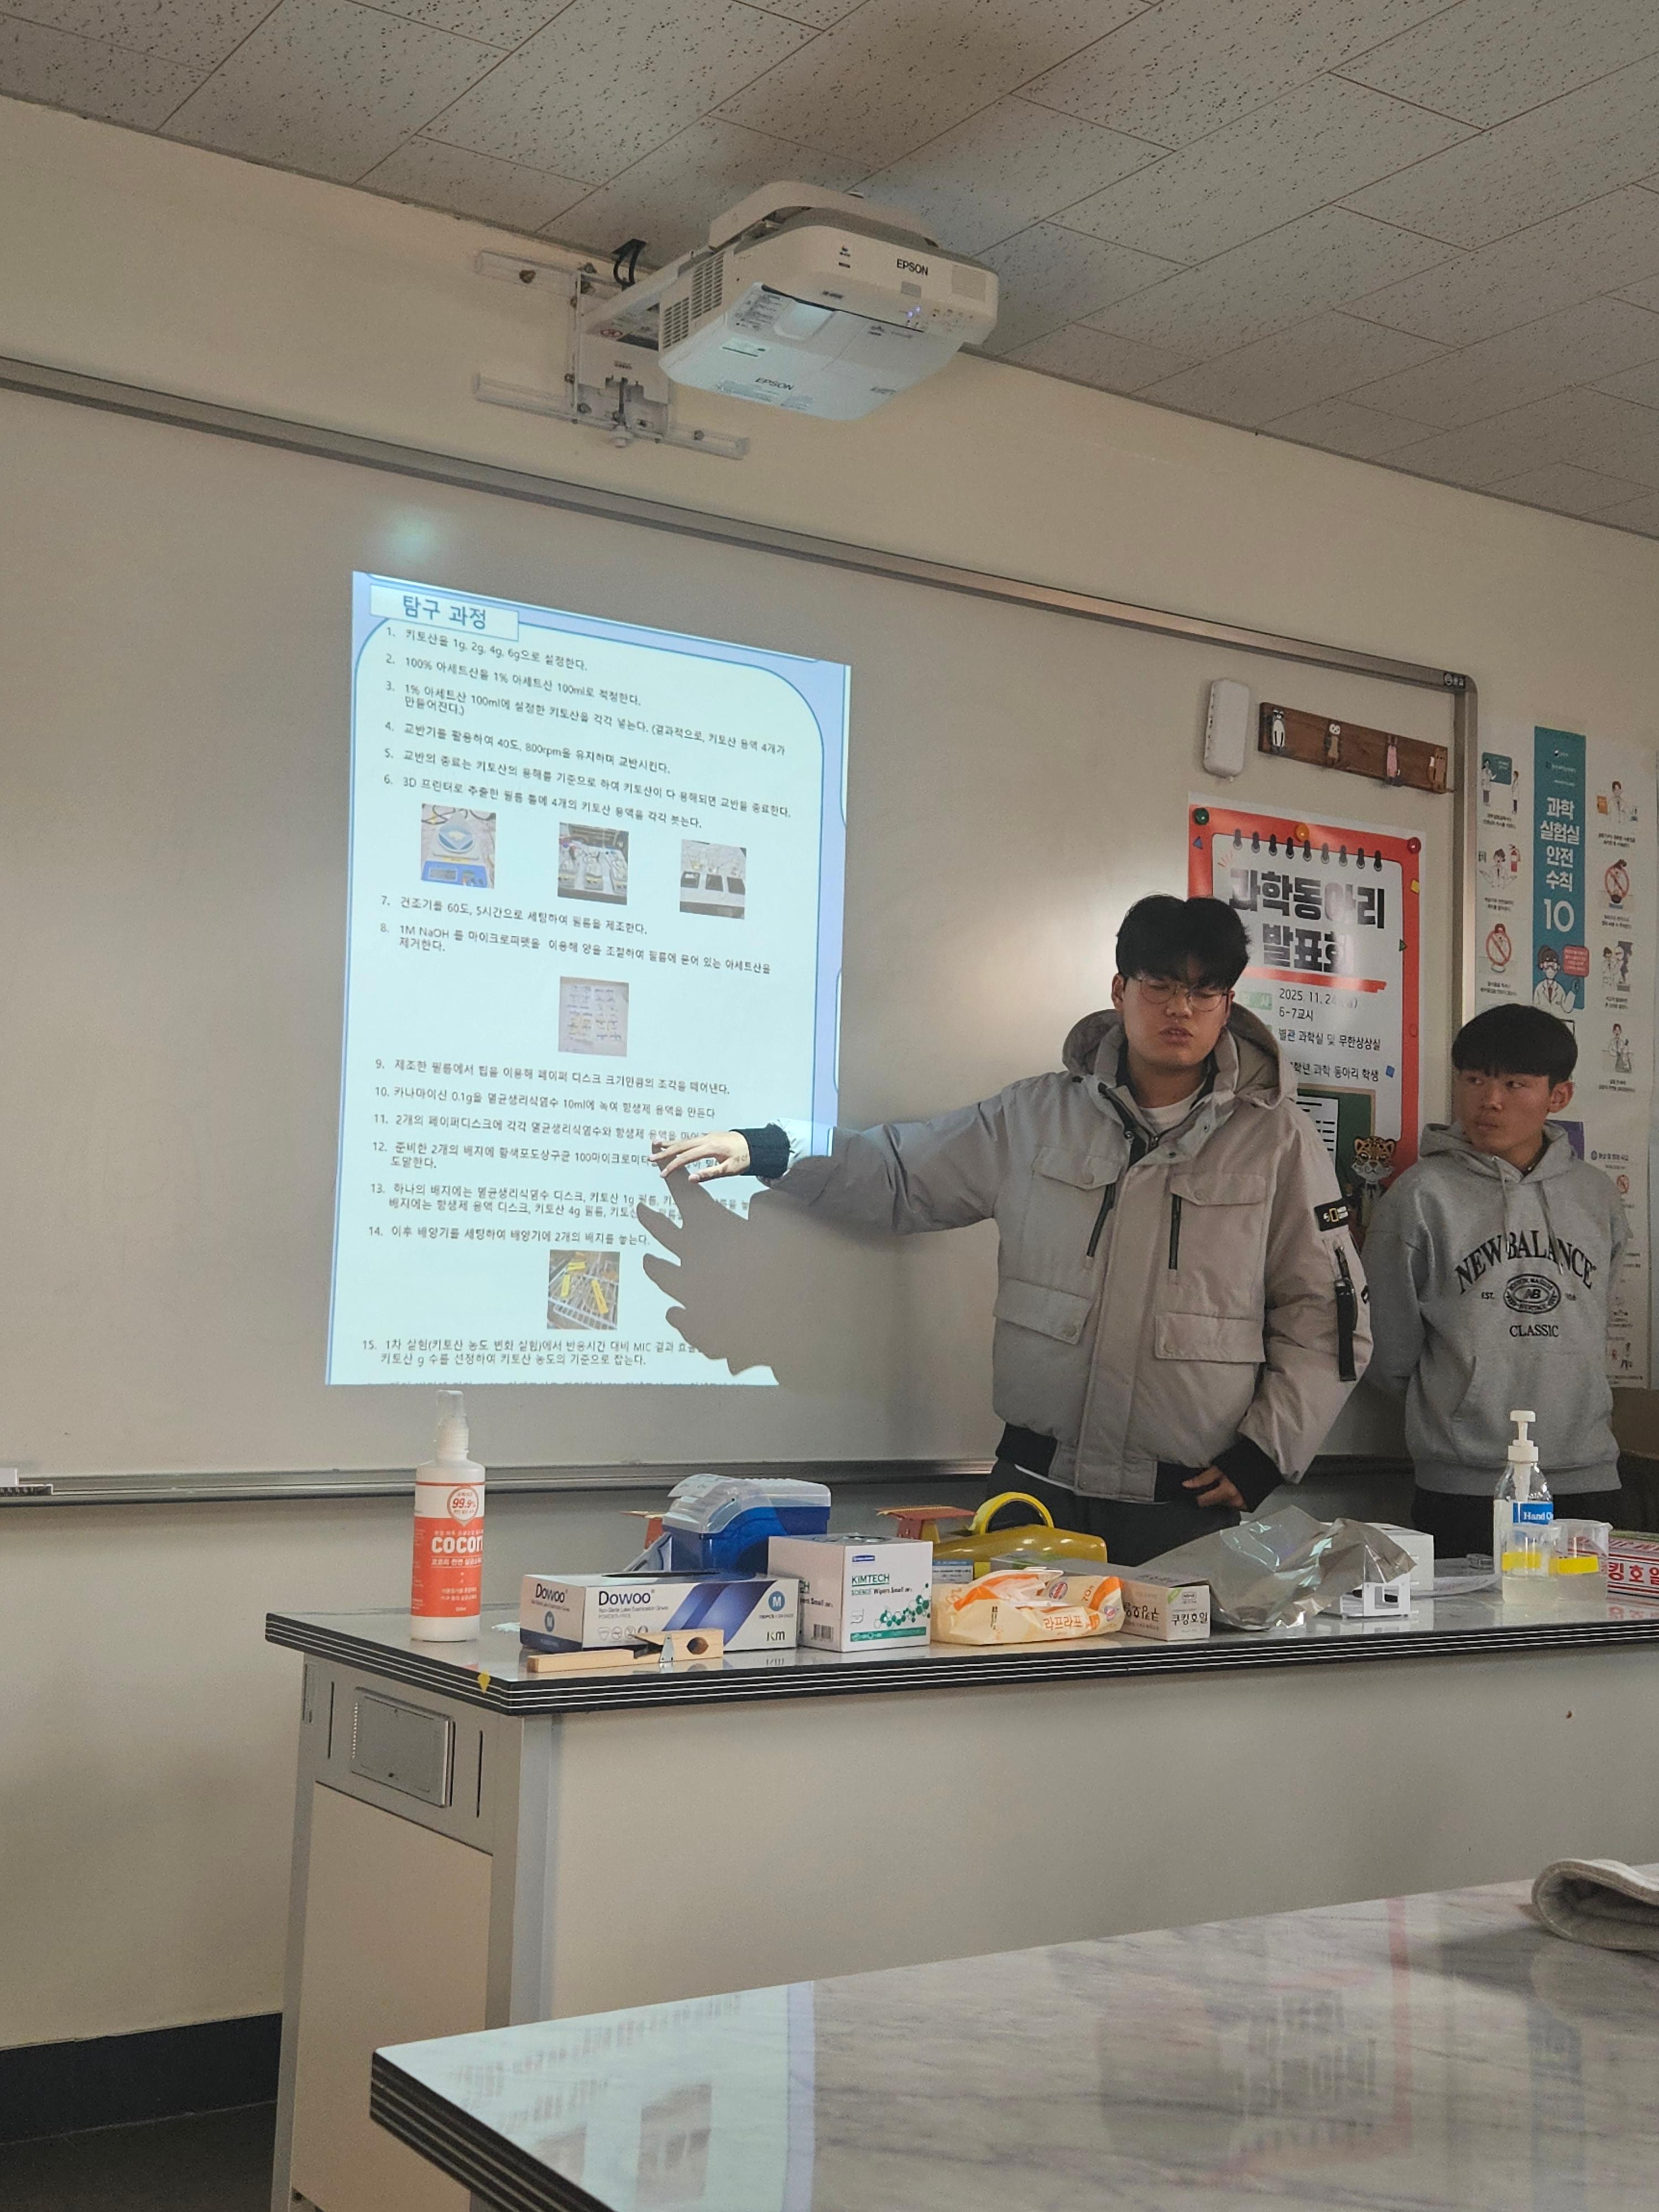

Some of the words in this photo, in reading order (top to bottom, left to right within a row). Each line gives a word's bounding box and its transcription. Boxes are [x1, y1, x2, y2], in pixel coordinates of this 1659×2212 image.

[896, 258, 928, 276] EPSON
[755, 377, 795, 390] EPSON
[403, 595, 441, 620] 탐구
[448, 606, 486, 630] 과정
[406, 629, 448, 648] 키토산을
[508, 648, 540, 662] 6g으로
[545, 654, 587, 671] 설정한다.
[405, 657, 432, 670] 100%
[436, 661, 488, 681] 아세트산을
[494, 672, 508, 684] 1%
[512, 674, 552, 692] 아세트산
[557, 682, 594, 697] 100ml로
[405, 684, 420, 695] 1%
[424, 686, 467, 703] 아세트산
[471, 695, 510, 711] 100ml에
[514, 701, 545, 716] 설정한
[549, 706, 588, 723] 키토산을
[593, 713, 612, 727] 각각
[708, 733, 736, 748] 키토산
[761, 743, 785, 756] 4개가
[404, 723, 447, 740] 교반기를
[497, 738, 521, 752] 40도,
[525, 742, 571, 759] 800rpm을
[575, 750, 614, 765] 유지하며
[619, 756, 670, 774] 교반시킨다.
[403, 750, 436, 765] 교반의
[476, 760, 517, 776] 키토산의
[556, 772, 596, 787] 기준으로
[600, 779, 619, 792] 하여
[623, 782, 662, 799] 키토산이
[666, 789, 676, 800] 다
[403, 776, 416, 787] 3D
[420, 778, 463, 794] 프린터로
[551, 797, 577, 810] 4개의
[582, 801, 611, 816] 키토산
[648, 811, 666, 823] 각각
[1546, 796, 1575, 820] 과학
[1540, 820, 1580, 845] 실험실
[1546, 845, 1574, 868] 안전
[1546, 870, 1573, 893] 수칙
[1229, 868, 1385, 929] 과학동아리
[400, 896, 442, 912] 건조기를
[447, 902, 472, 916] 60도,
[476, 906, 523, 920] 5시간으로
[527, 911, 567, 926] 세팅하여
[606, 920, 647, 935] 제조한다.
[1543, 898, 1575, 932] 10
[399, 936, 445, 952] 제거한다.
[400, 925, 415, 935] 1M
[419, 926, 449, 938] NaOH
[549, 940, 578, 953] 이용해
[725, 959, 770, 974] 아세트산을
[1310, 991, 1322, 1004] 11.
[1279, 1006, 1313, 1022] 6-7교시
[1299, 1030, 1324, 1045] 과학실
[1339, 1035, 1381, 1051] 무한상상실
[394, 1059, 426, 1073] 제조한
[503, 1067, 533, 1079] 이용해
[538, 1069, 567, 1082] 페이퍼
[572, 1072, 601, 1084] 디스크
[658, 1079, 686, 1092] 조각을
[1290, 1061, 1311, 1076] 학년
[1313, 1063, 1331, 1077] 과학
[1333, 1065, 1359, 1079] 동아리
[1361, 1068, 1379, 1082] 학생
[394, 1086, 447, 1101] 카나마이신
[451, 1091, 482, 1105] 0.1g을
[488, 1092, 559, 1108] 멸균생리식염수
[564, 1099, 594, 1110] 10ml에
[622, 1102, 650, 1115] 항생제
[687, 1107, 715, 1119] 만든다
[395, 1114, 423, 1126] 2개의
[428, 1115, 502, 1131] 페이퍼디스크에
[507, 1120, 526, 1133] 각각
[531, 1121, 612, 1137] 멸균생리식염수와
[615, 1127, 644, 1139] 항생제
[395, 1141, 427, 1155] 준비한
[431, 1144, 458, 1156] 2개의
[463, 1145, 494, 1158] 배지에
[390, 1156, 436, 1169] 도말한다.
[394, 1183, 425, 1196] 하나의
[430, 1185, 472, 1198] 배지에는
[477, 1186, 549, 1201] 멸균생리식염수
[554, 1190, 586, 1203] 디스크,
[589, 1191, 618, 1204] 키토산
[623, 1194, 634, 1207] 1g
[389, 1197, 432, 1211] 배지에는
[436, 1199, 468, 1211] 항생제
[498, 1201, 531, 1214] 디스크,
[535, 1203, 564, 1215] 키토산
[568, 1206, 580, 1218] 4g
[391, 1225, 413, 1237] 이후
[418, 1226, 460, 1239] 배양기를
[464, 1228, 505, 1240] 세팅하여
[510, 1229, 551, 1243] 배양기에
[554, 1232, 580, 1243] 2개의
[585, 1232, 614, 1245] 배지를
[1454, 1235, 1503, 1295] NEW
[1507, 1229, 1593, 1290] BALANCE
[1509, 1324, 1559, 1338] CLASSIC
[386, 1338, 401, 1350] 1차
[407, 1338, 463, 1352] 실험(키토산
[468, 1339, 488, 1351] 농도
[494, 1339, 513, 1352] 변화
[518, 1339, 562, 1352] 실험)에서
[566, 1340, 606, 1353] 반응시간
[610, 1340, 629, 1352] 대비
[633, 1342, 651, 1352] MIC
[655, 1341, 674, 1353] 결과
[381, 1352, 413, 1365] 키토산
[418, 1357, 424, 1366] g
[429, 1353, 450, 1365] 수를
[454, 1353, 495, 1365] 선정하여
[500, 1353, 531, 1365] 키토산
[535, 1354, 565, 1365] 농도의
[570, 1354, 609, 1365] 기준으로
[614, 1354, 646, 1366] 잡는다.
[1523, 1511, 1546, 1521] Hand
[852, 1573, 890, 1584] KIMTECH
[1608, 1562, 1659, 1585] 킹호일
[535, 1583, 565, 1604] Dowoo
[598, 1590, 651, 1606] Dowoo
[772, 1596, 781, 1608] M
[1042, 1615, 1083, 1631] 라프라프
[1171, 1611, 1208, 1626] 쿠킹호일
